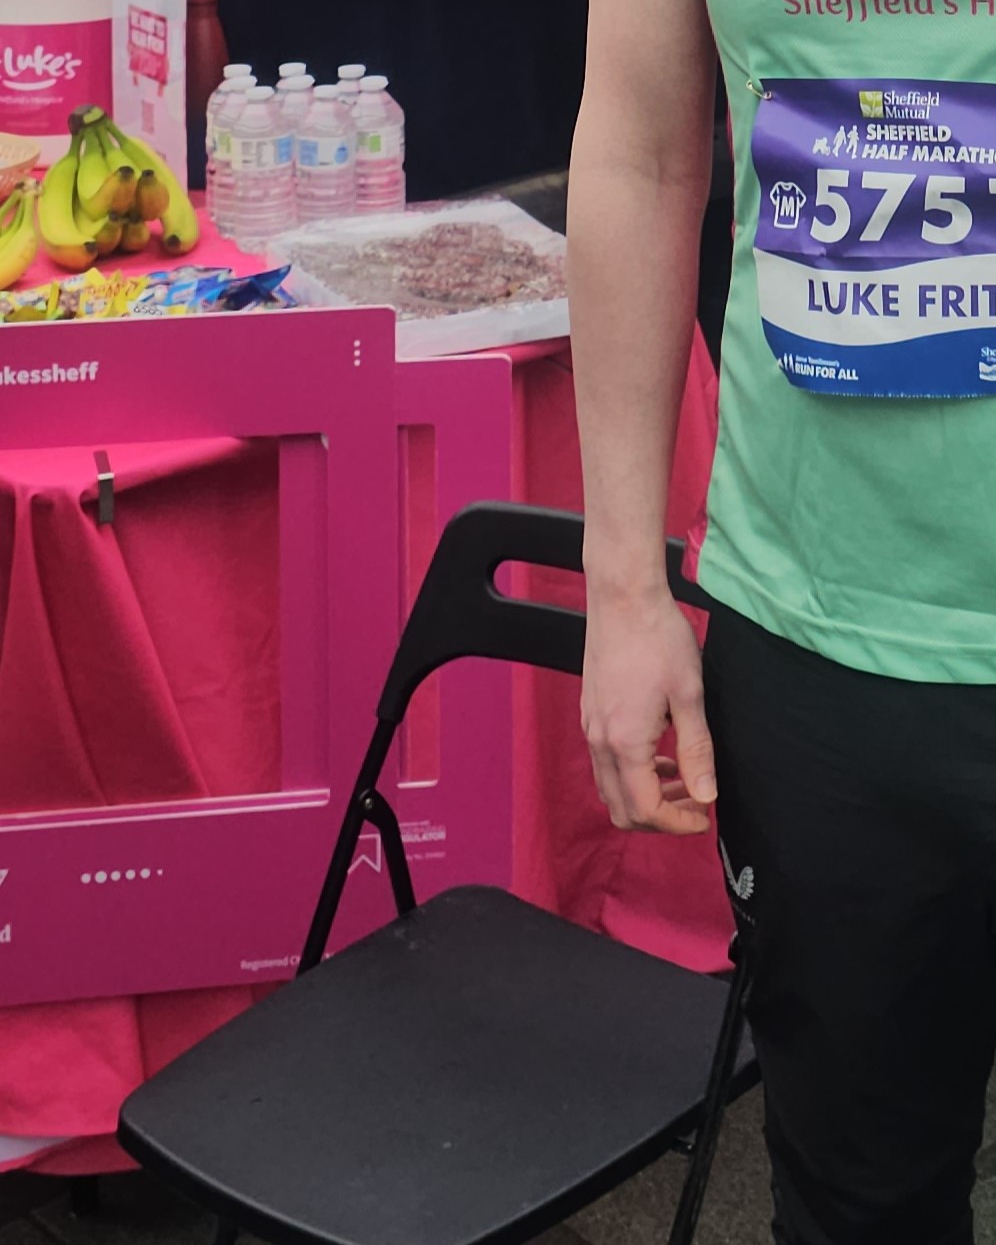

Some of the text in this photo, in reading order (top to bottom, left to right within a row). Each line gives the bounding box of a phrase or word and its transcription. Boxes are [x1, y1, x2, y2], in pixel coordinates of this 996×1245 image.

[4, 45, 82, 80] Luke's
[883, 90, 940, 106] Sheffield
[885, 106, 931, 120] Mutual
[866, 124, 952, 143] SHEFFIELD
[861, 144, 909, 162] HALF
[780, 200, 796, 218] M
[807, 279, 900, 317] LUKE
[795, 363, 859, 381] RUN FOR ALL
